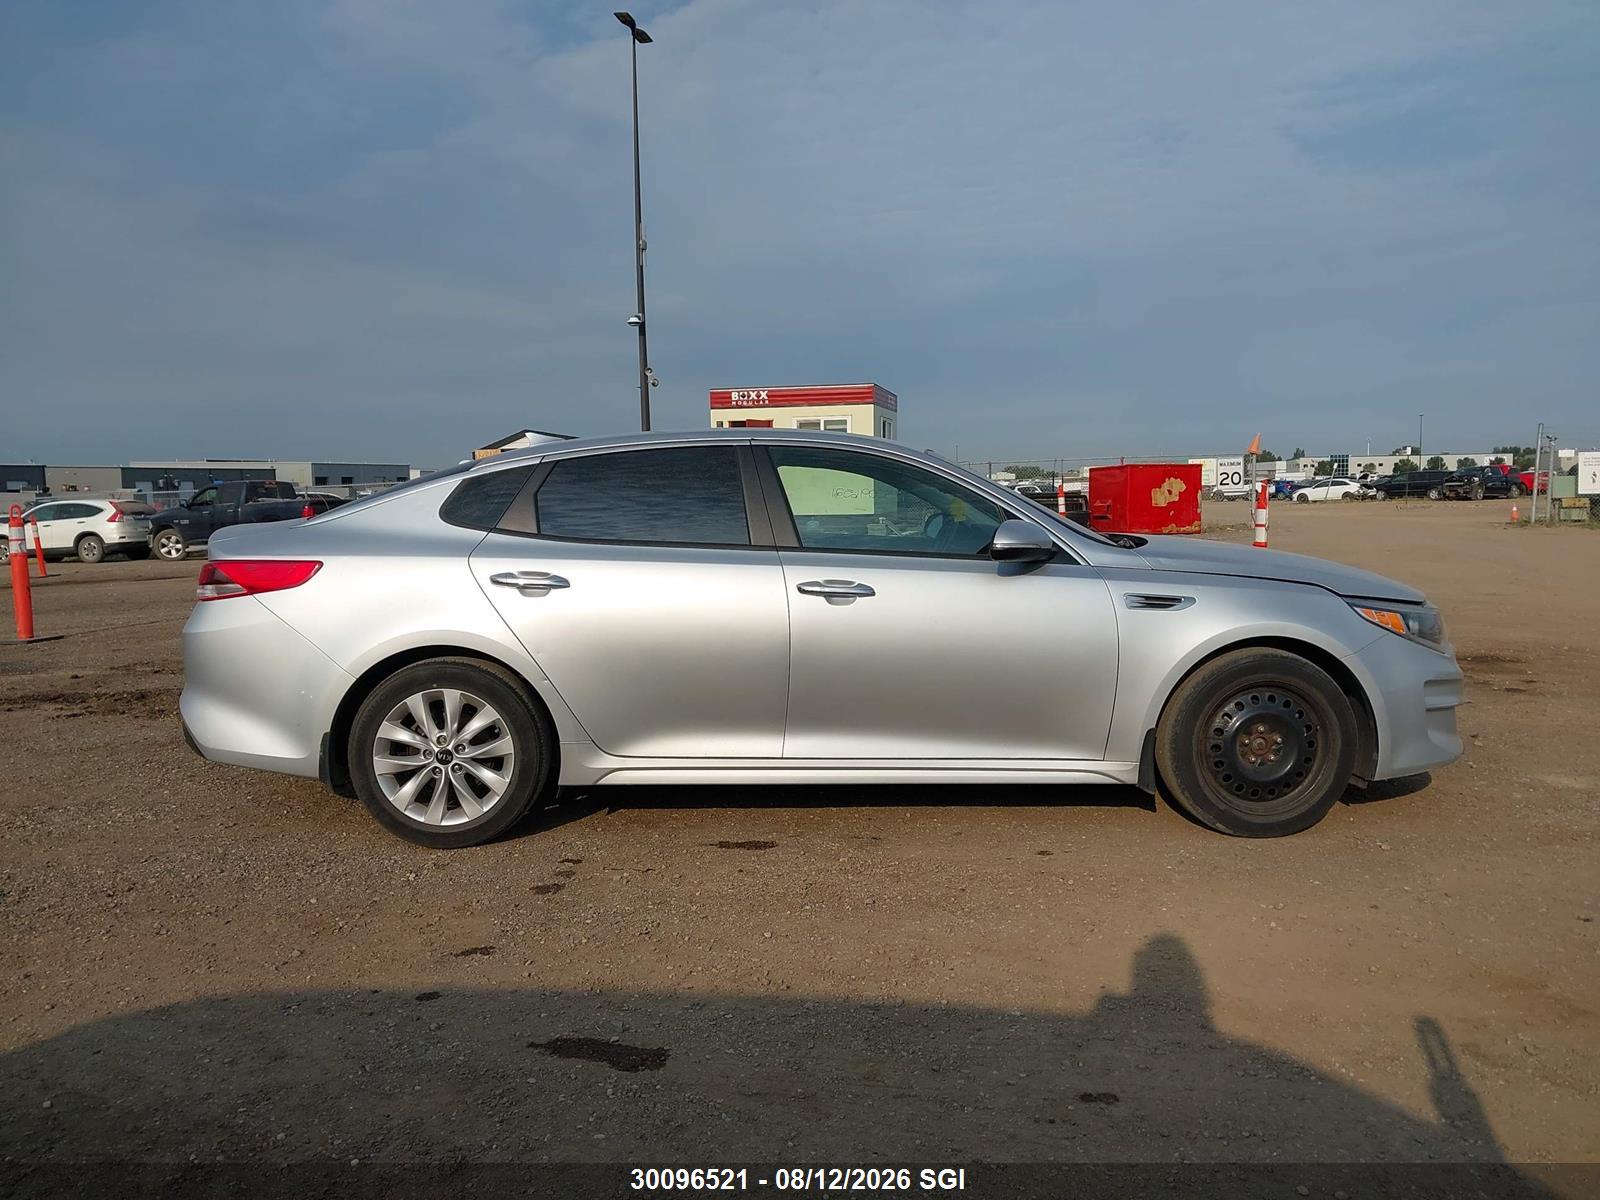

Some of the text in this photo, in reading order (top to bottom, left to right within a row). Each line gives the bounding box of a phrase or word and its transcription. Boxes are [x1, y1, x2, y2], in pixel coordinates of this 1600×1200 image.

[732, 391, 768, 400] BOXX
[1220, 472, 1241, 486] 20
[437, 752, 452, 761] KIA
